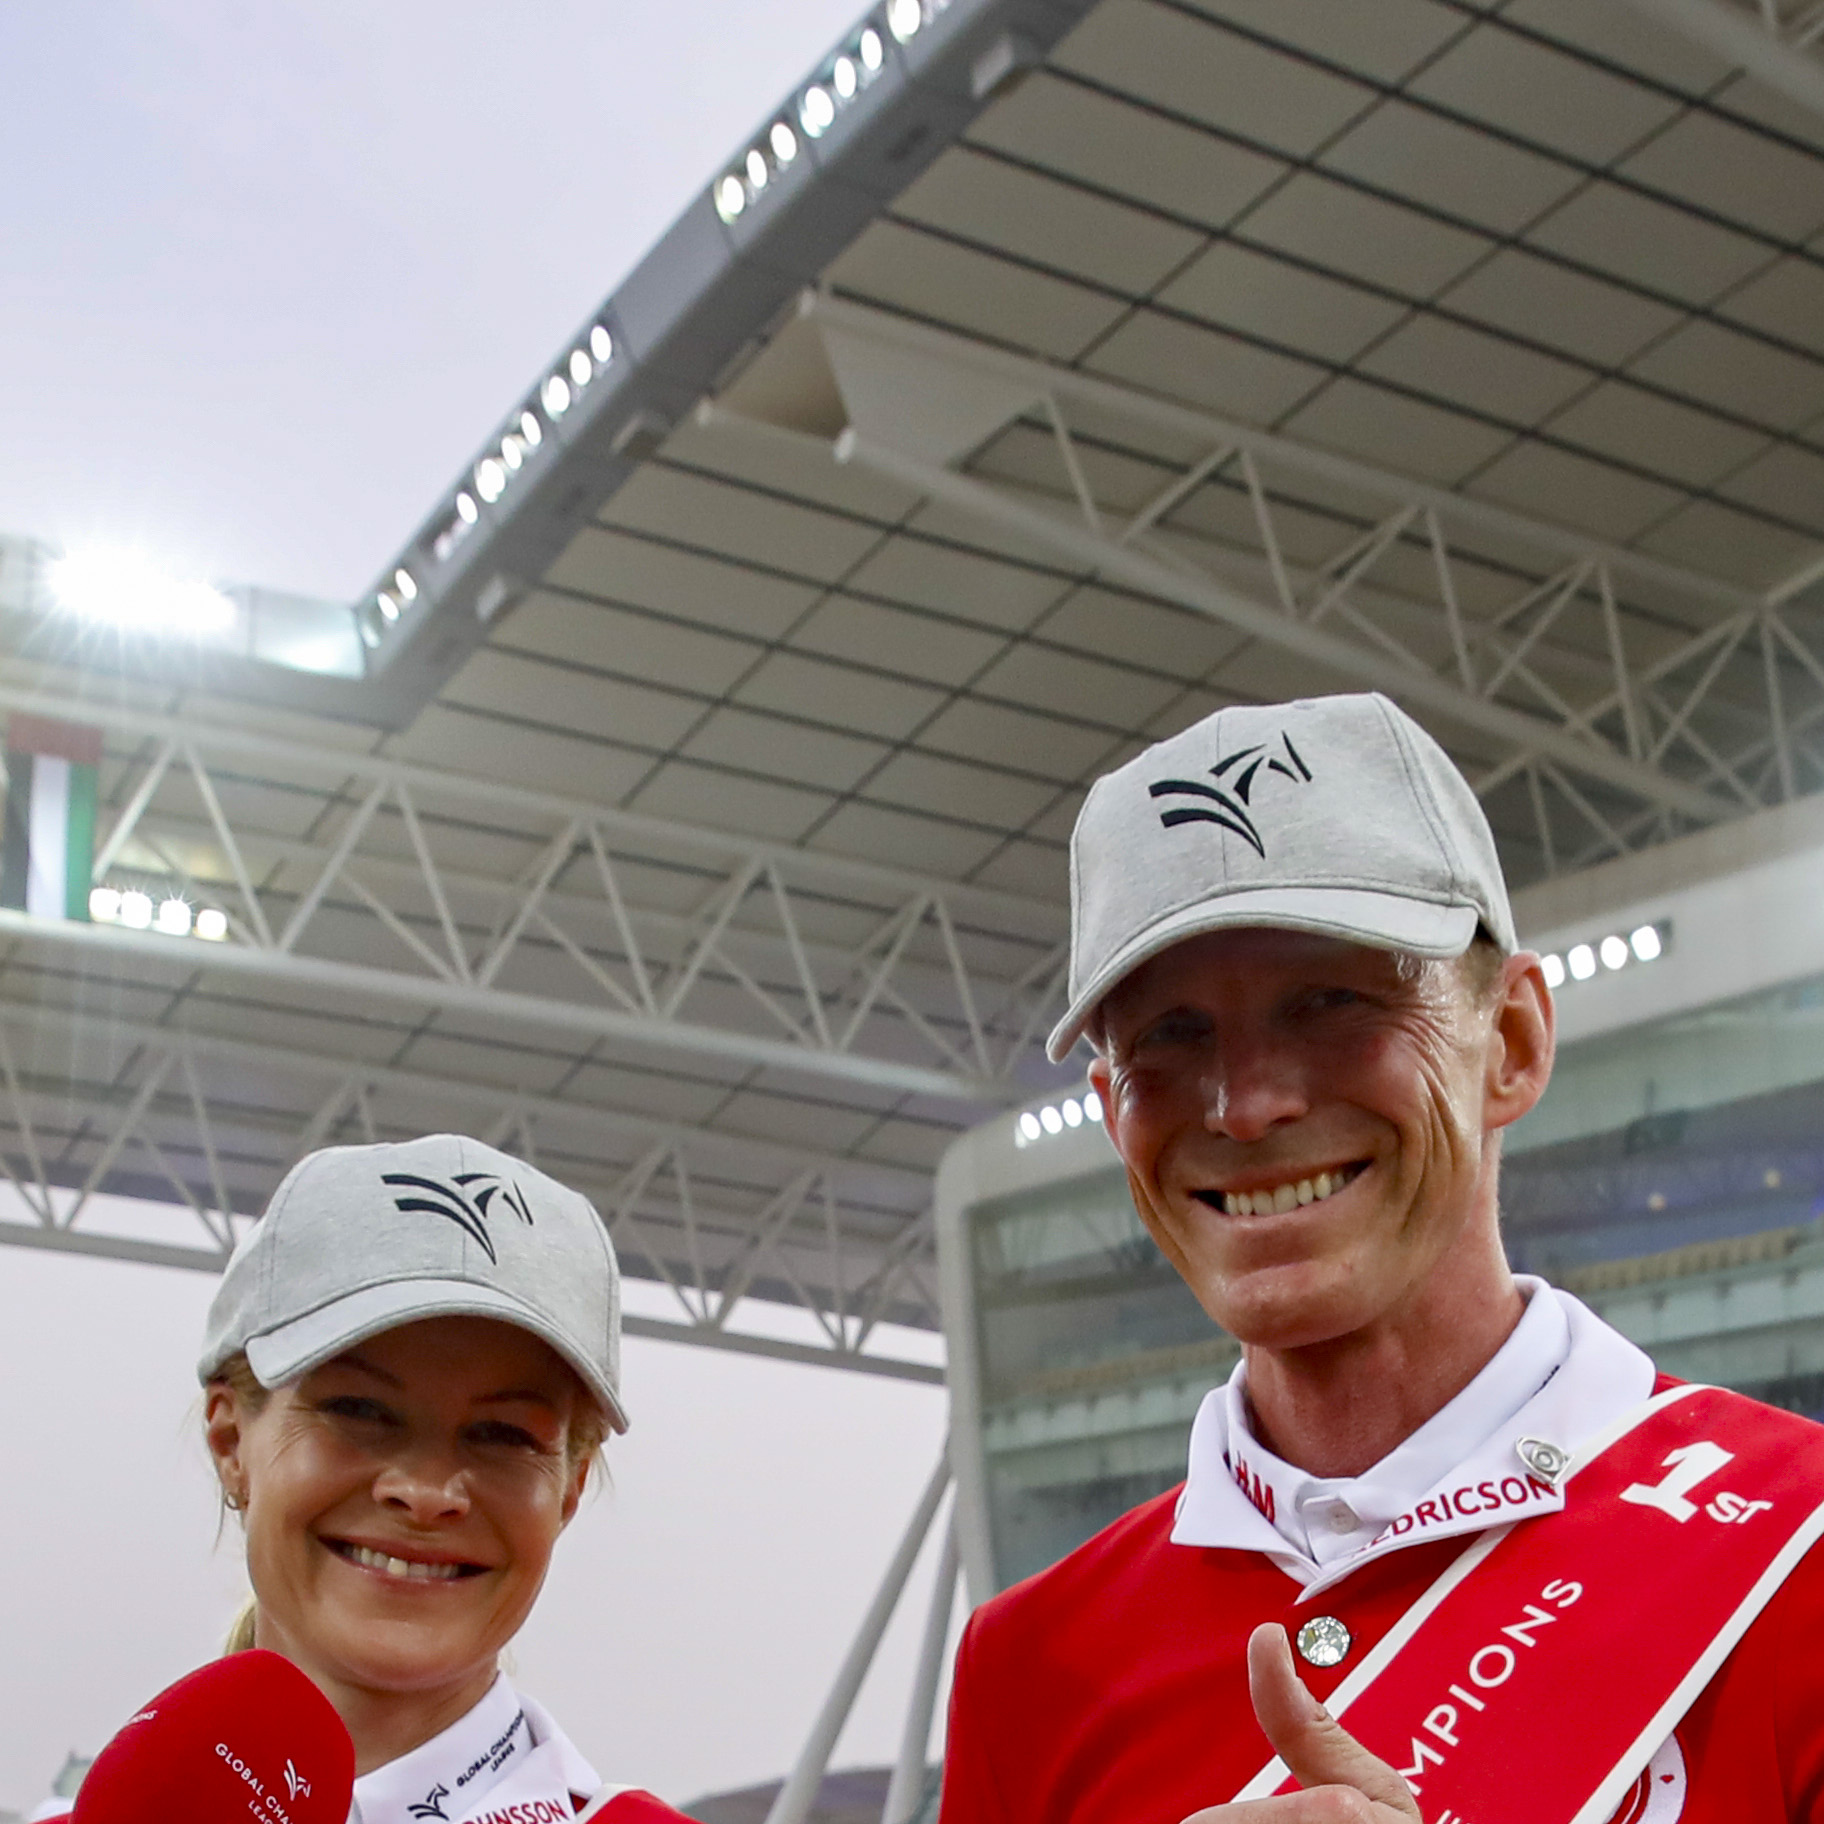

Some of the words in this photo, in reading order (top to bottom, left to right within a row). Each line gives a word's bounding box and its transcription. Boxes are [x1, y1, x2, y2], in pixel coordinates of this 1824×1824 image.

[1236, 1450, 1275, 1525] HM
[1359, 1473, 1558, 1552] DRICSON
[1397, 1579, 1583, 1797] MPIONS
[215, 1743, 264, 1797] GLOBAL
